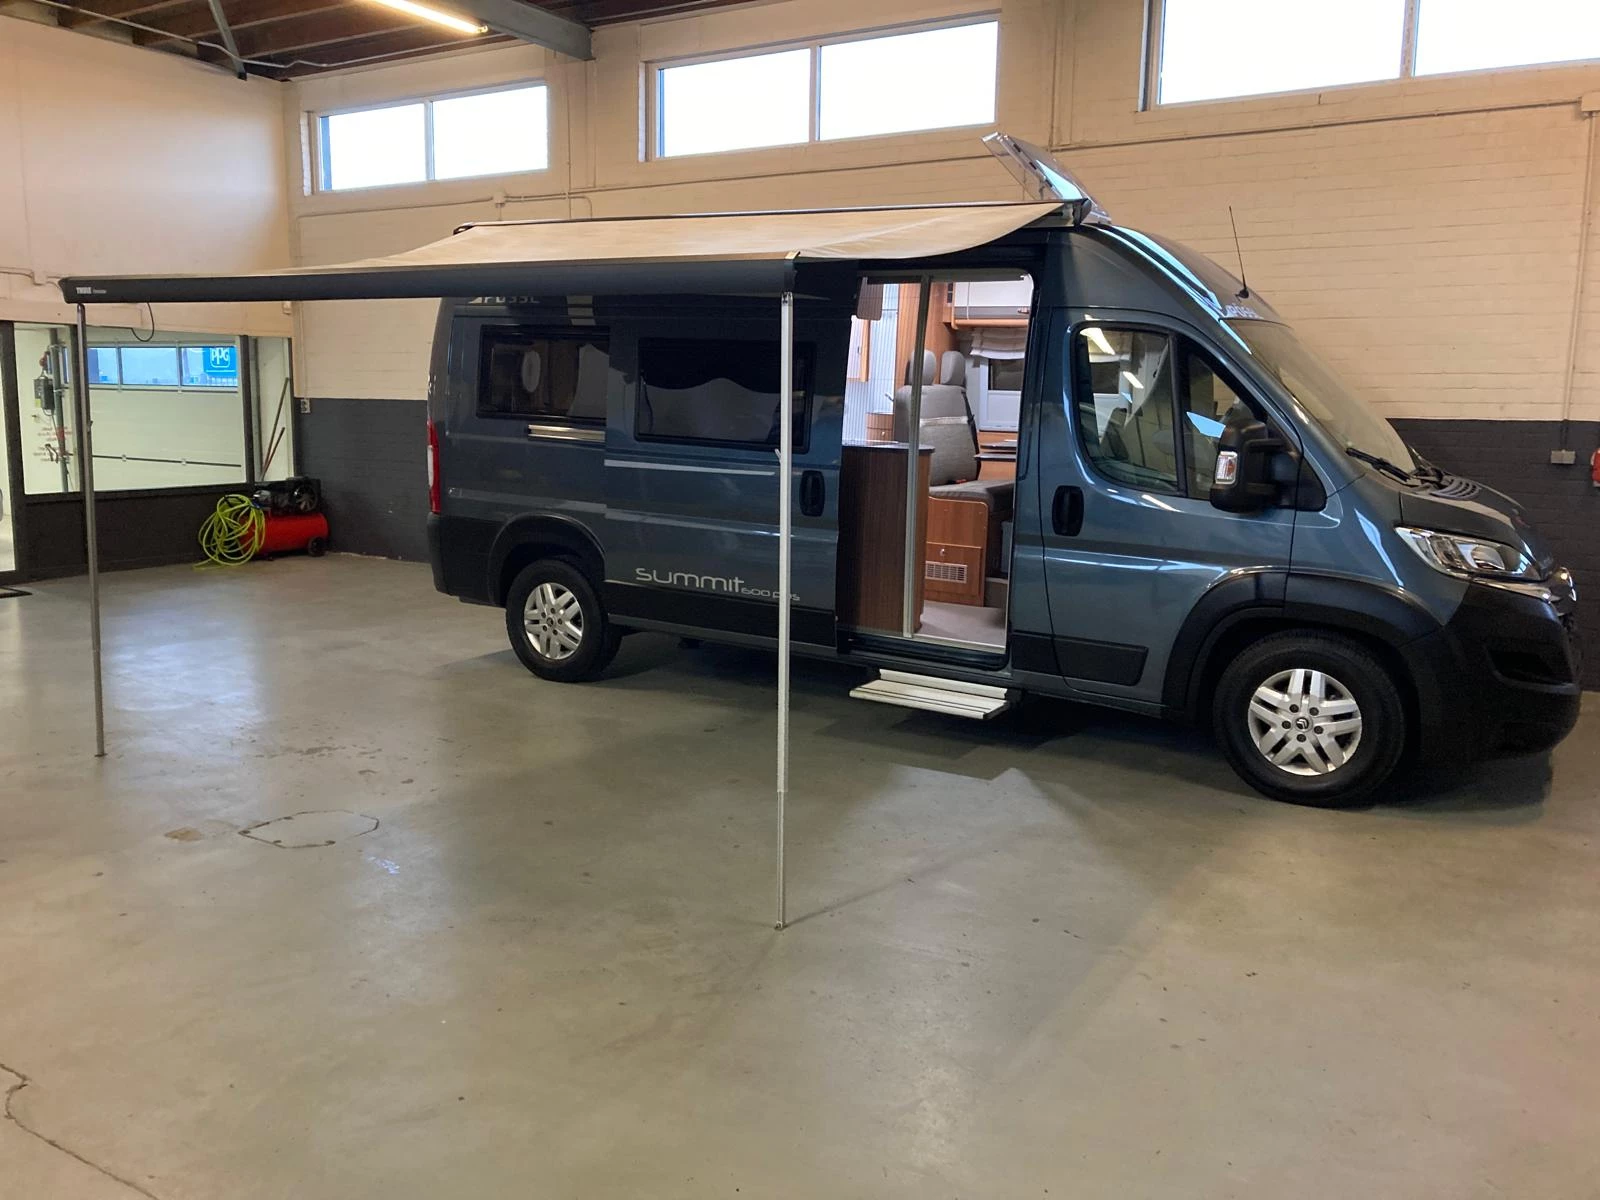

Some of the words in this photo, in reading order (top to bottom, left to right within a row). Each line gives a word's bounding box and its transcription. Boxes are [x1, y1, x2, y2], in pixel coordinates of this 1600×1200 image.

[211, 348, 230, 365] PPG
[741, 587, 771, 598] 600
[773, 591, 801, 601] ps
